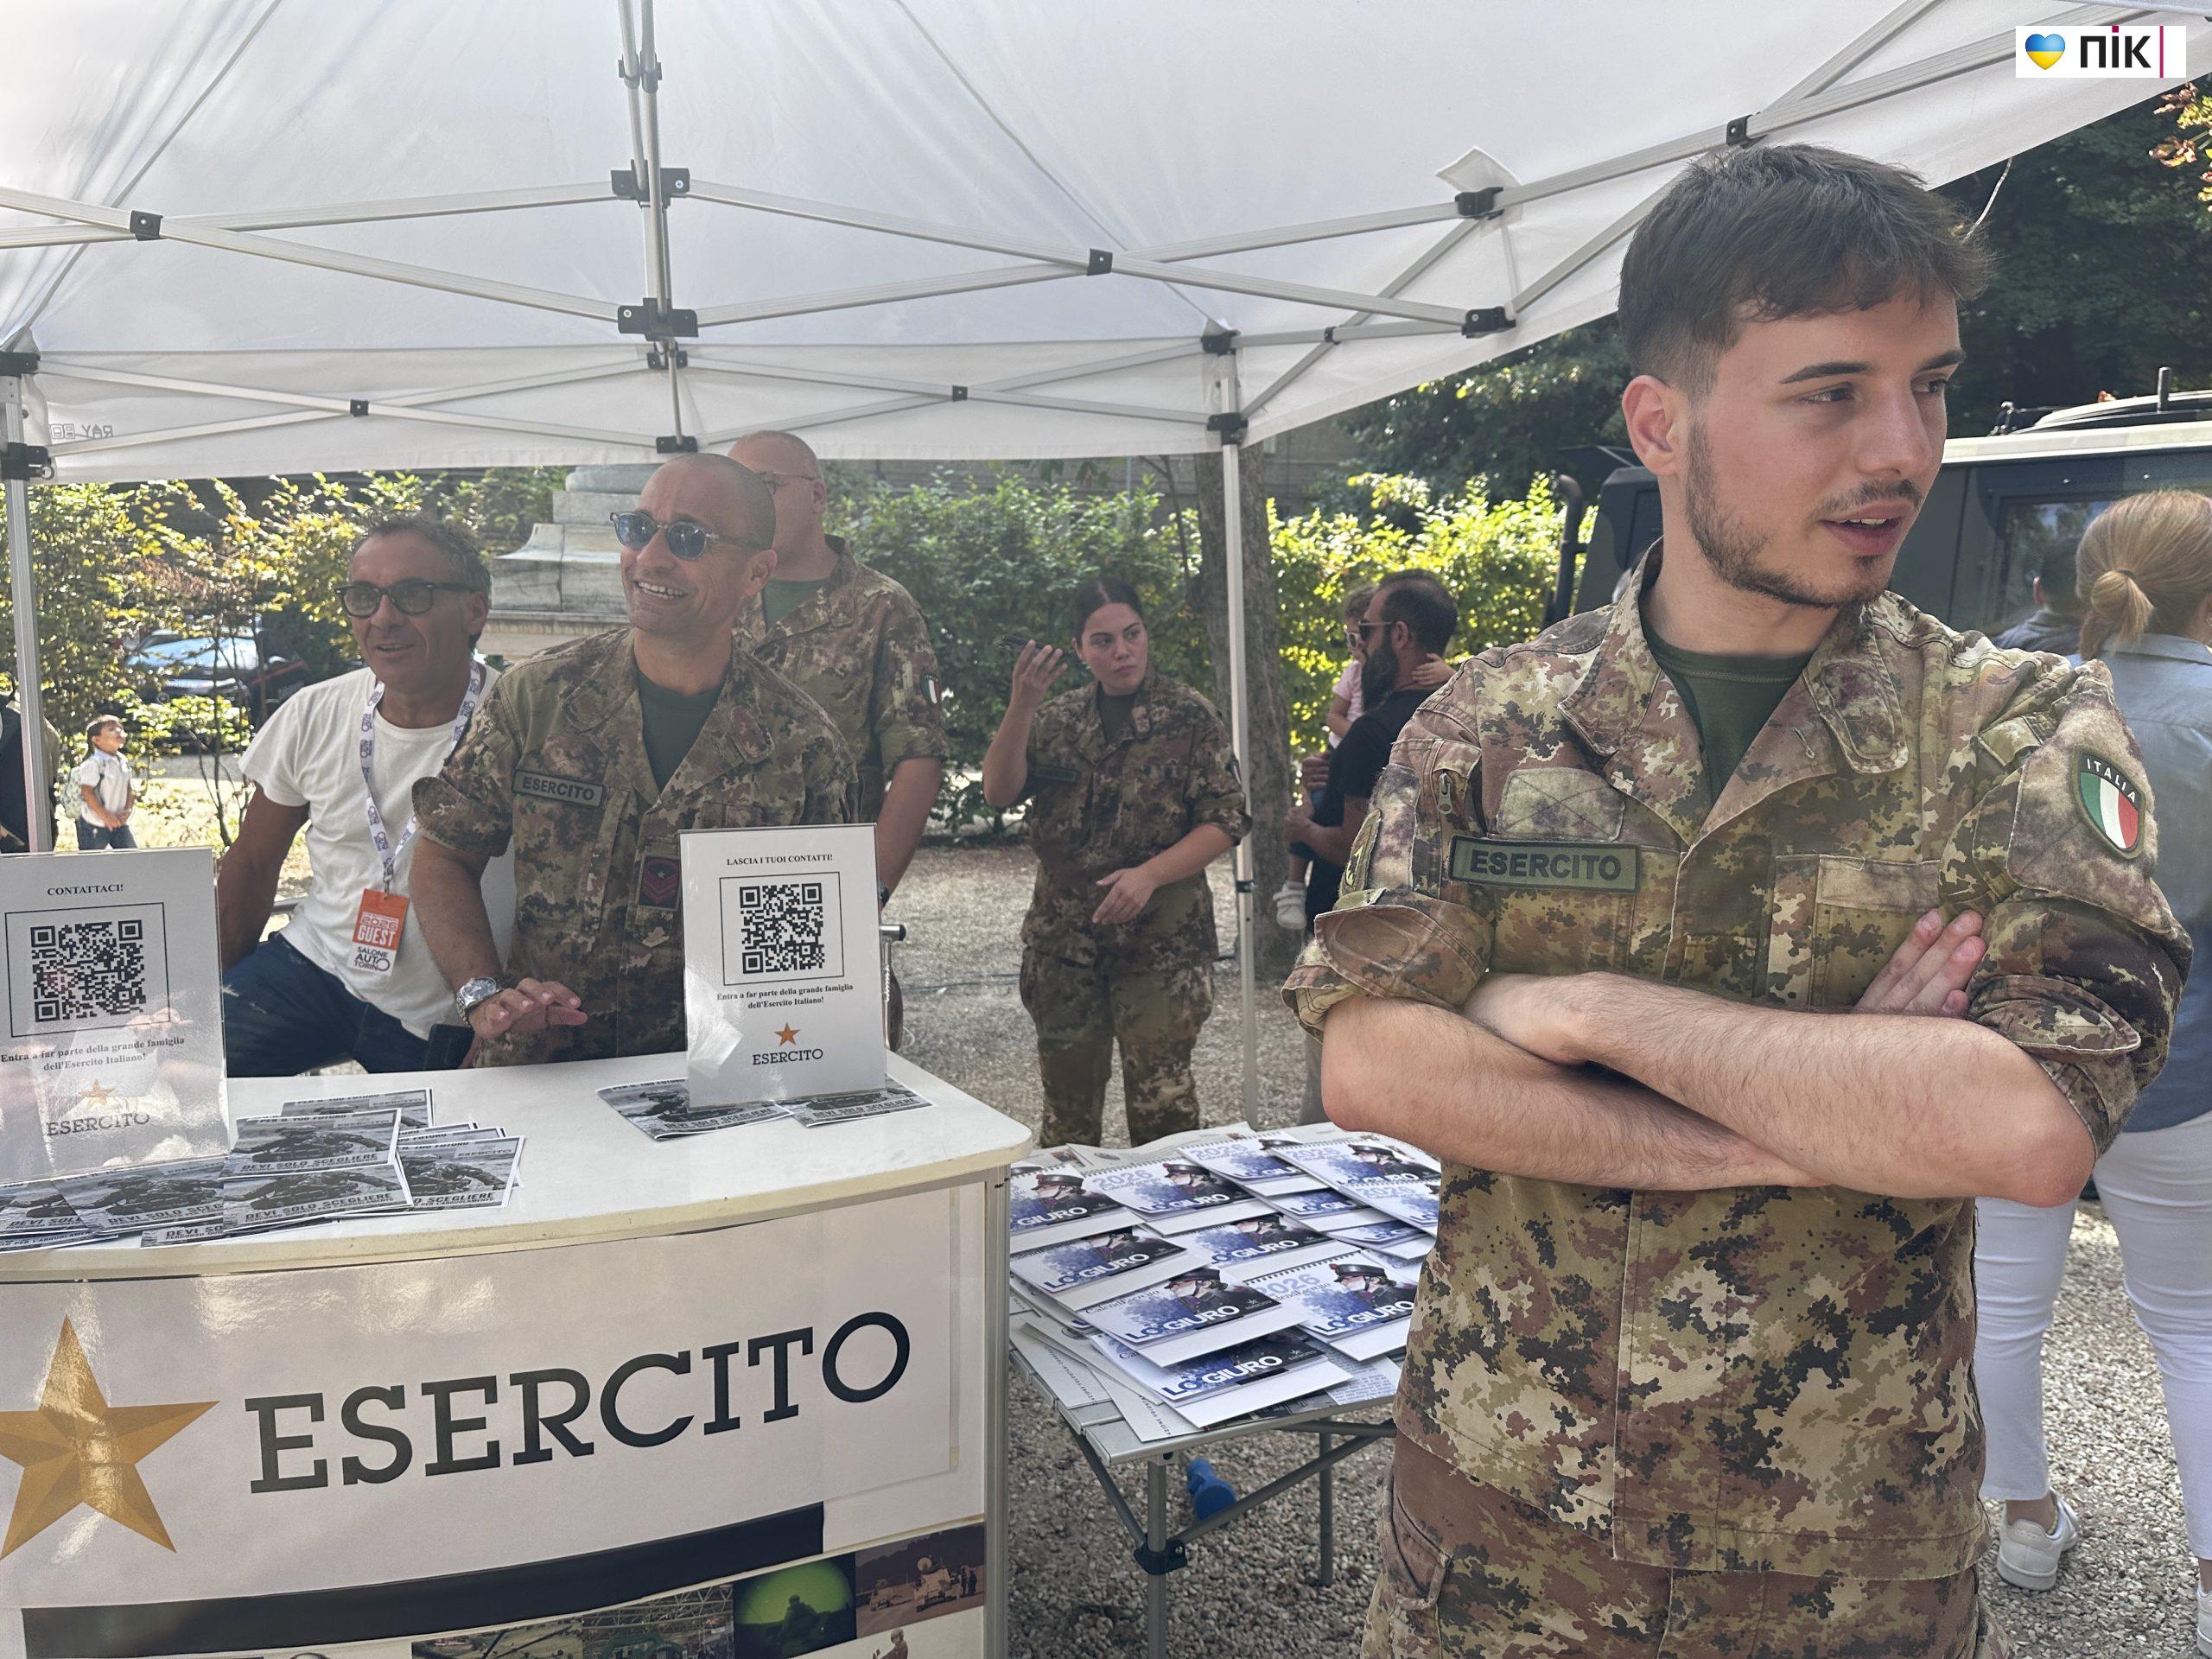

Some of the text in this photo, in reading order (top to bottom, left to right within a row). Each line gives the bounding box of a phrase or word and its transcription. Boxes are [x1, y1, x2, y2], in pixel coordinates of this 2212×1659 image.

[523, 776, 594, 801] ESERCITO
[2087, 758, 2136, 803] ITALIA
[727, 857, 759, 866] LASCIA
[766, 855, 786, 864] TUOI
[788, 854, 833, 862] CONTATTI!
[1470, 849, 1622, 881] ESERCITO
[47, 883, 124, 896] CONTATTACI!
[361, 916, 398, 930] 2026
[357, 924, 397, 947] GUEST
[357, 946, 389, 958] SALONE
[759, 990, 779, 999] parte
[779, 987, 797, 995] della
[798, 986, 823, 995] grande
[824, 983, 854, 993] famiglia
[748, 996, 824, 1009] dell'Esercito Italiano!
[1, 1053, 29, 1063] Entra
[41, 1050, 55, 1058] far
[57, 1048, 84, 1059] parte
[86, 1044, 109, 1054] della
[111, 1039, 145, 1053] grande
[147, 1037, 185, 1049] famiglia
[752, 1048, 823, 1065] ESERCITO
[43, 1052, 147, 1071] dell'Esercito Italiano!
[46, 1111, 150, 1136] ESERCITO
[313, 1153, 378, 1166] SCEGLIERE
[1092, 1170, 1153, 1189] 2026
[245, 1192, 393, 1220] DEVI SOLO SCEGLIERE
[427, 1192, 494, 1203] SCEGLIERE
[1168, 1193, 1230, 1210] GIURO
[108, 1215, 141, 1224] DEVI
[146, 1210, 182, 1218] SOLO
[1017, 1207, 1088, 1225] GIURO
[166, 1228, 198, 1236] DEVI
[1231, 1240, 1299, 1258] GIURO
[1044, 1274, 1079, 1288] LO
[1079, 1253, 1150, 1278] GIURO
[1126, 1305, 1240, 1339] LO GIURO
[1313, 1300, 1414, 1332] LO GIURO
[1161, 1356, 1283, 1396] LO GIURO
[245, 1311, 911, 1494] ESERCITO
